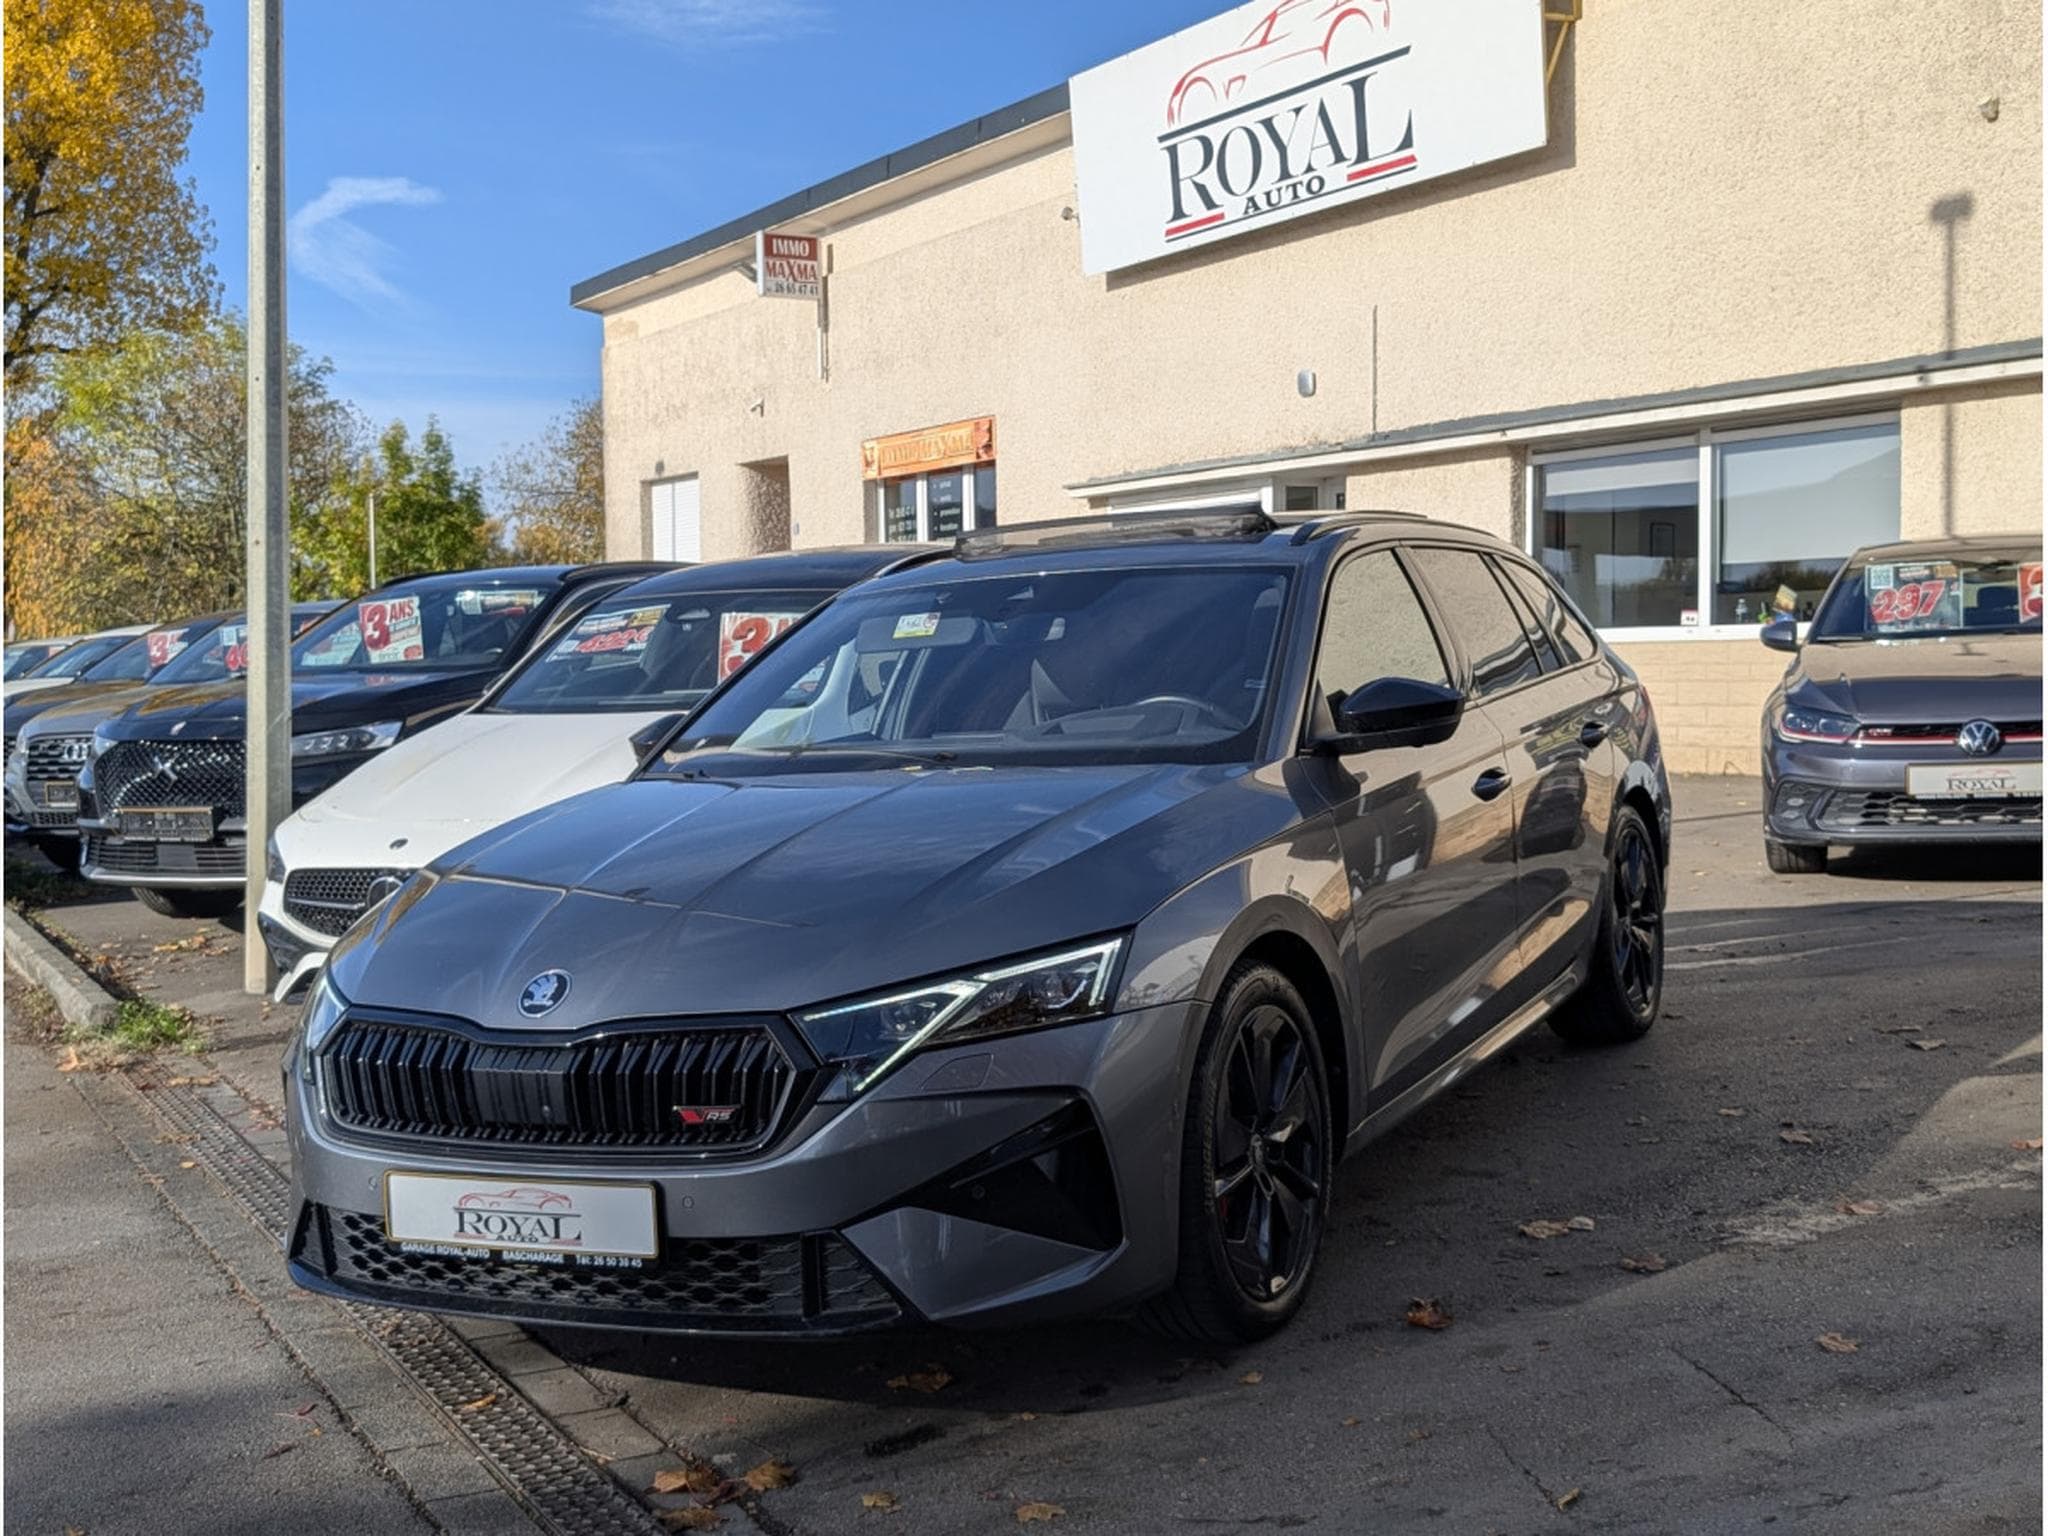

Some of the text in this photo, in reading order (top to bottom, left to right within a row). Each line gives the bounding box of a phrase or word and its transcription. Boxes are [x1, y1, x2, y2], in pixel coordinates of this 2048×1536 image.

[1160, 72, 1414, 224] ROYAL
[1243, 175, 1326, 216] AUTO
[772, 238, 810, 257] IMMO
[767, 260, 817, 282] MAXMA
[1871, 580, 1946, 623] 297
[366, 604, 390, 651] 3
[389, 600, 415, 622] ANS
[1946, 778, 2016, 791] ROYAL
[456, 1211, 582, 1240] ROYAL
[496, 1234, 539, 1243] AUTO
[401, 1242, 436, 1255] GARAGE
[502, 1250, 564, 1264] BASCHARAGE
